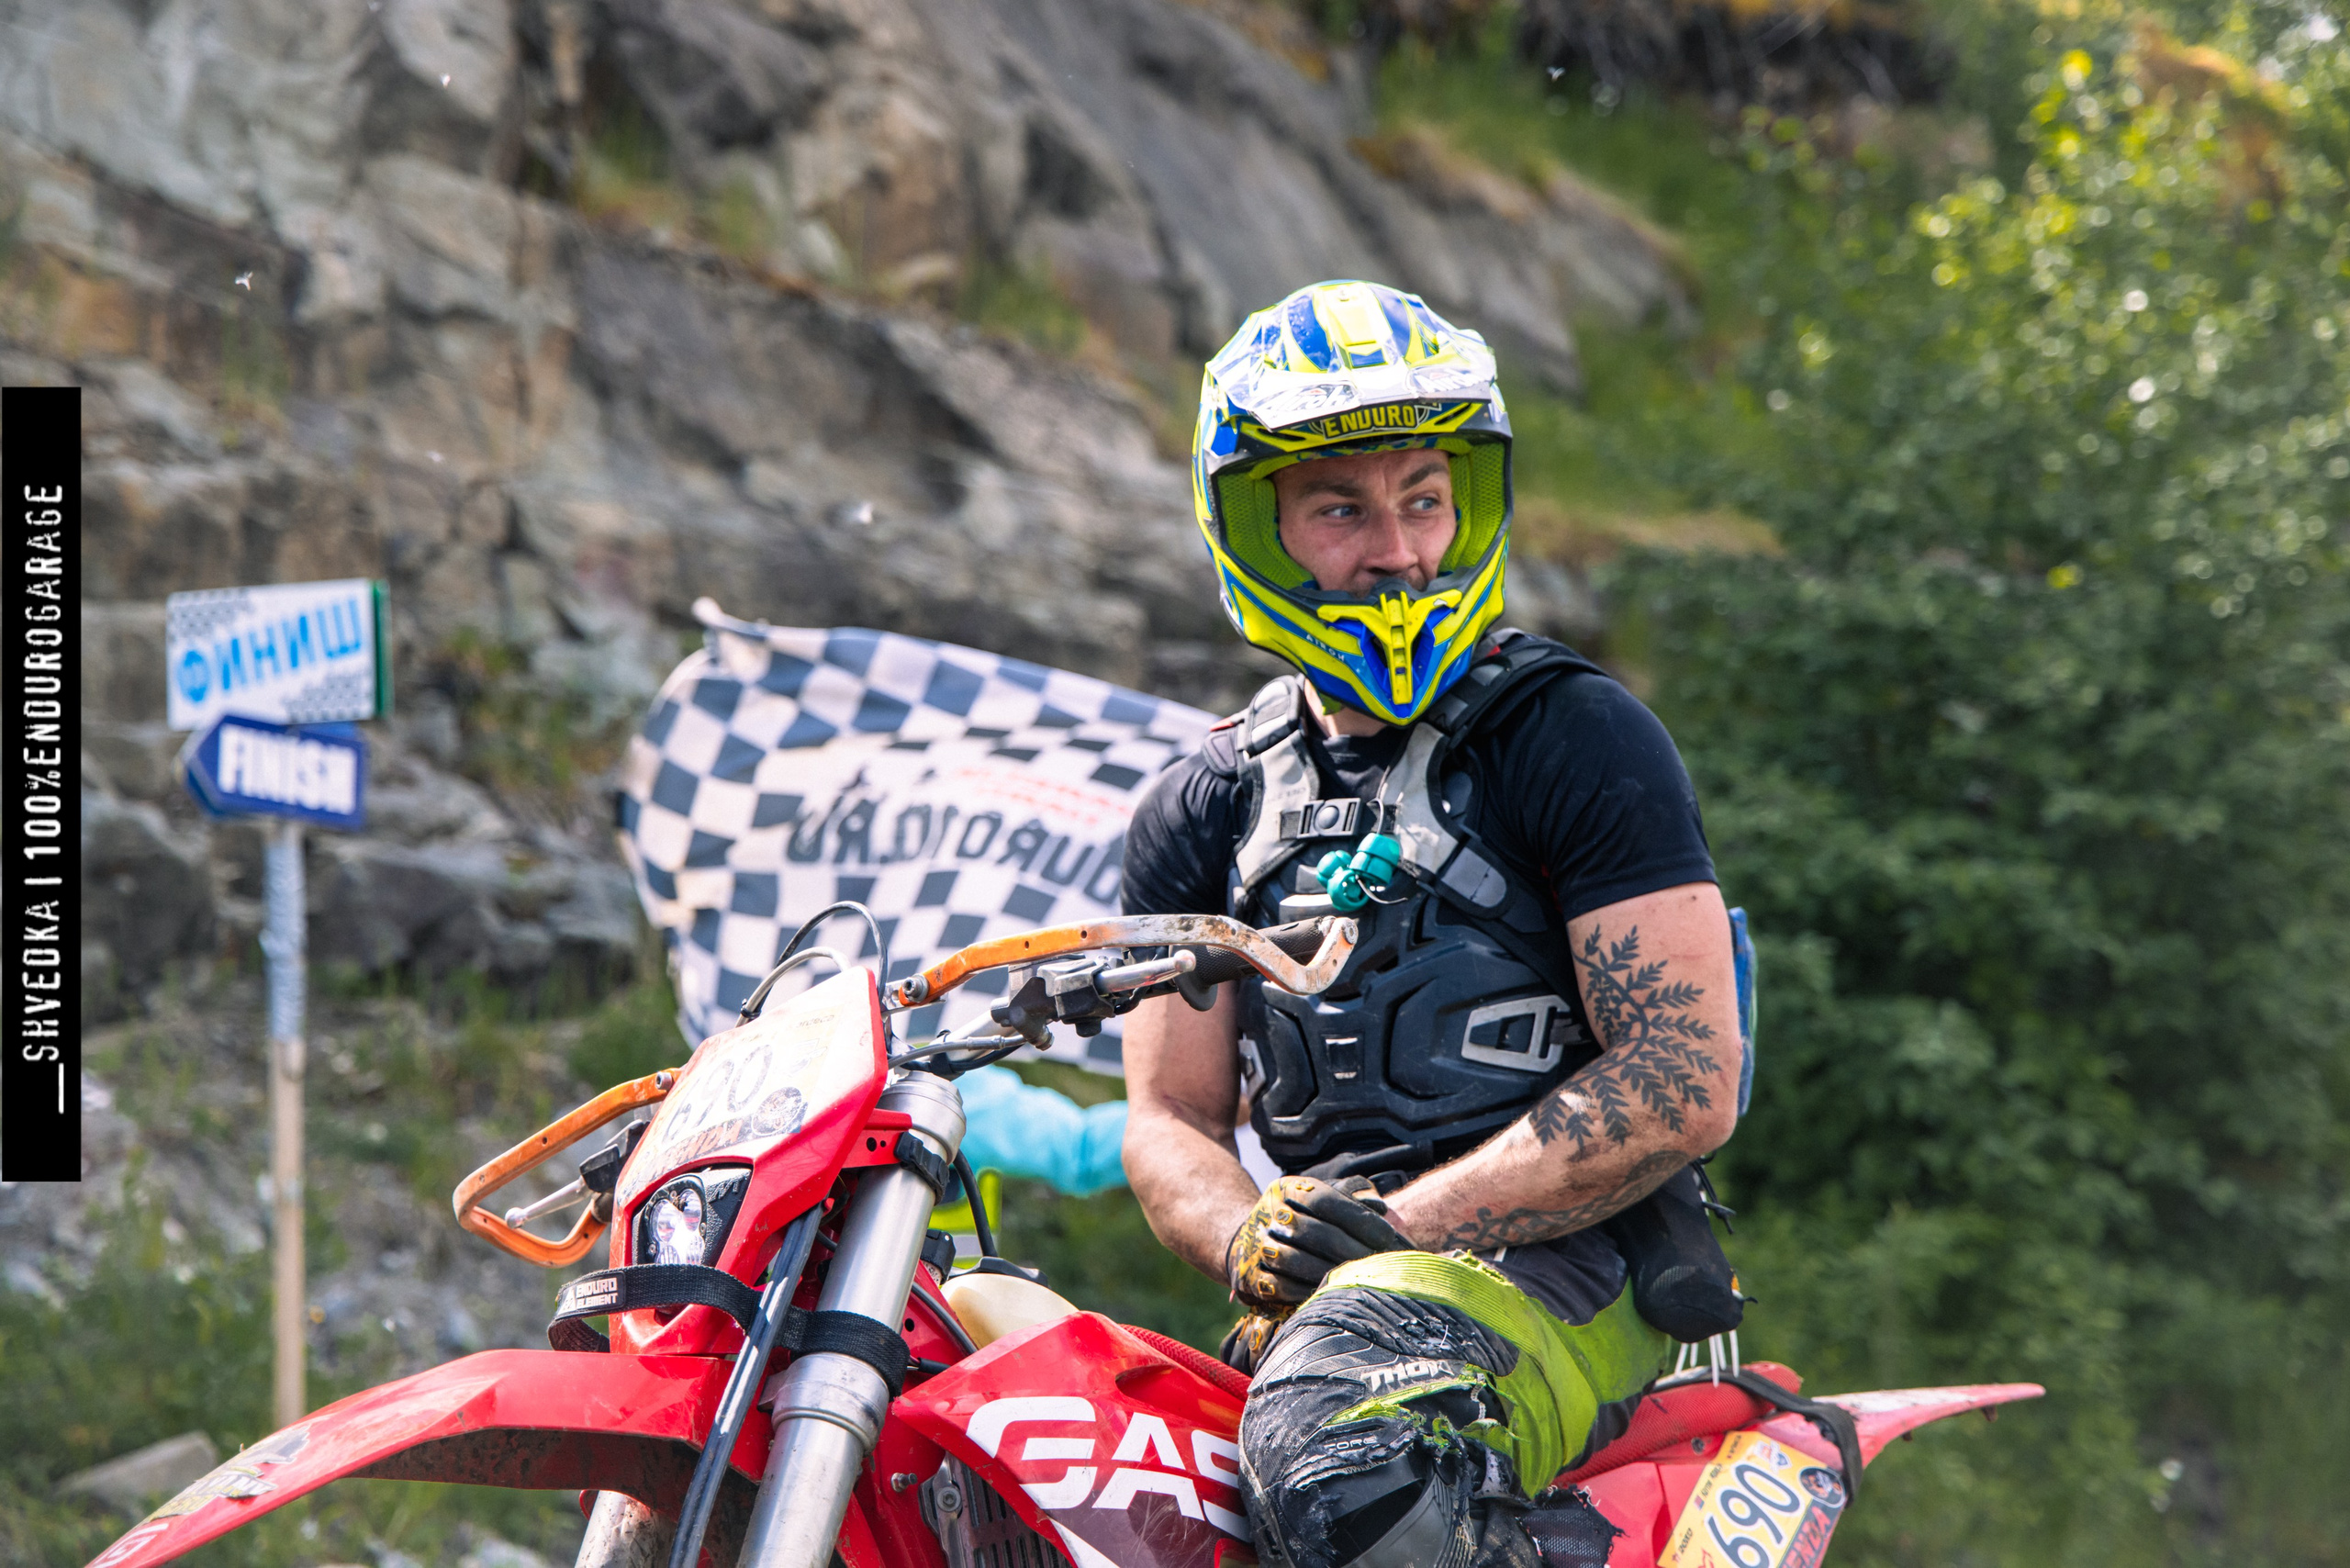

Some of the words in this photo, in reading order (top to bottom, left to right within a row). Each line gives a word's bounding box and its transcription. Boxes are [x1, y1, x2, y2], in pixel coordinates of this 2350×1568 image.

[1326, 406, 1416, 437] ENDURO
[176, 599, 361, 703] ФИНИШ
[1306, 633, 1345, 661] AIROH
[576, 1277, 617, 1298] ENDURO
[576, 1293, 618, 1310] ELEMENT
[1708, 1463, 1800, 1567] 690
